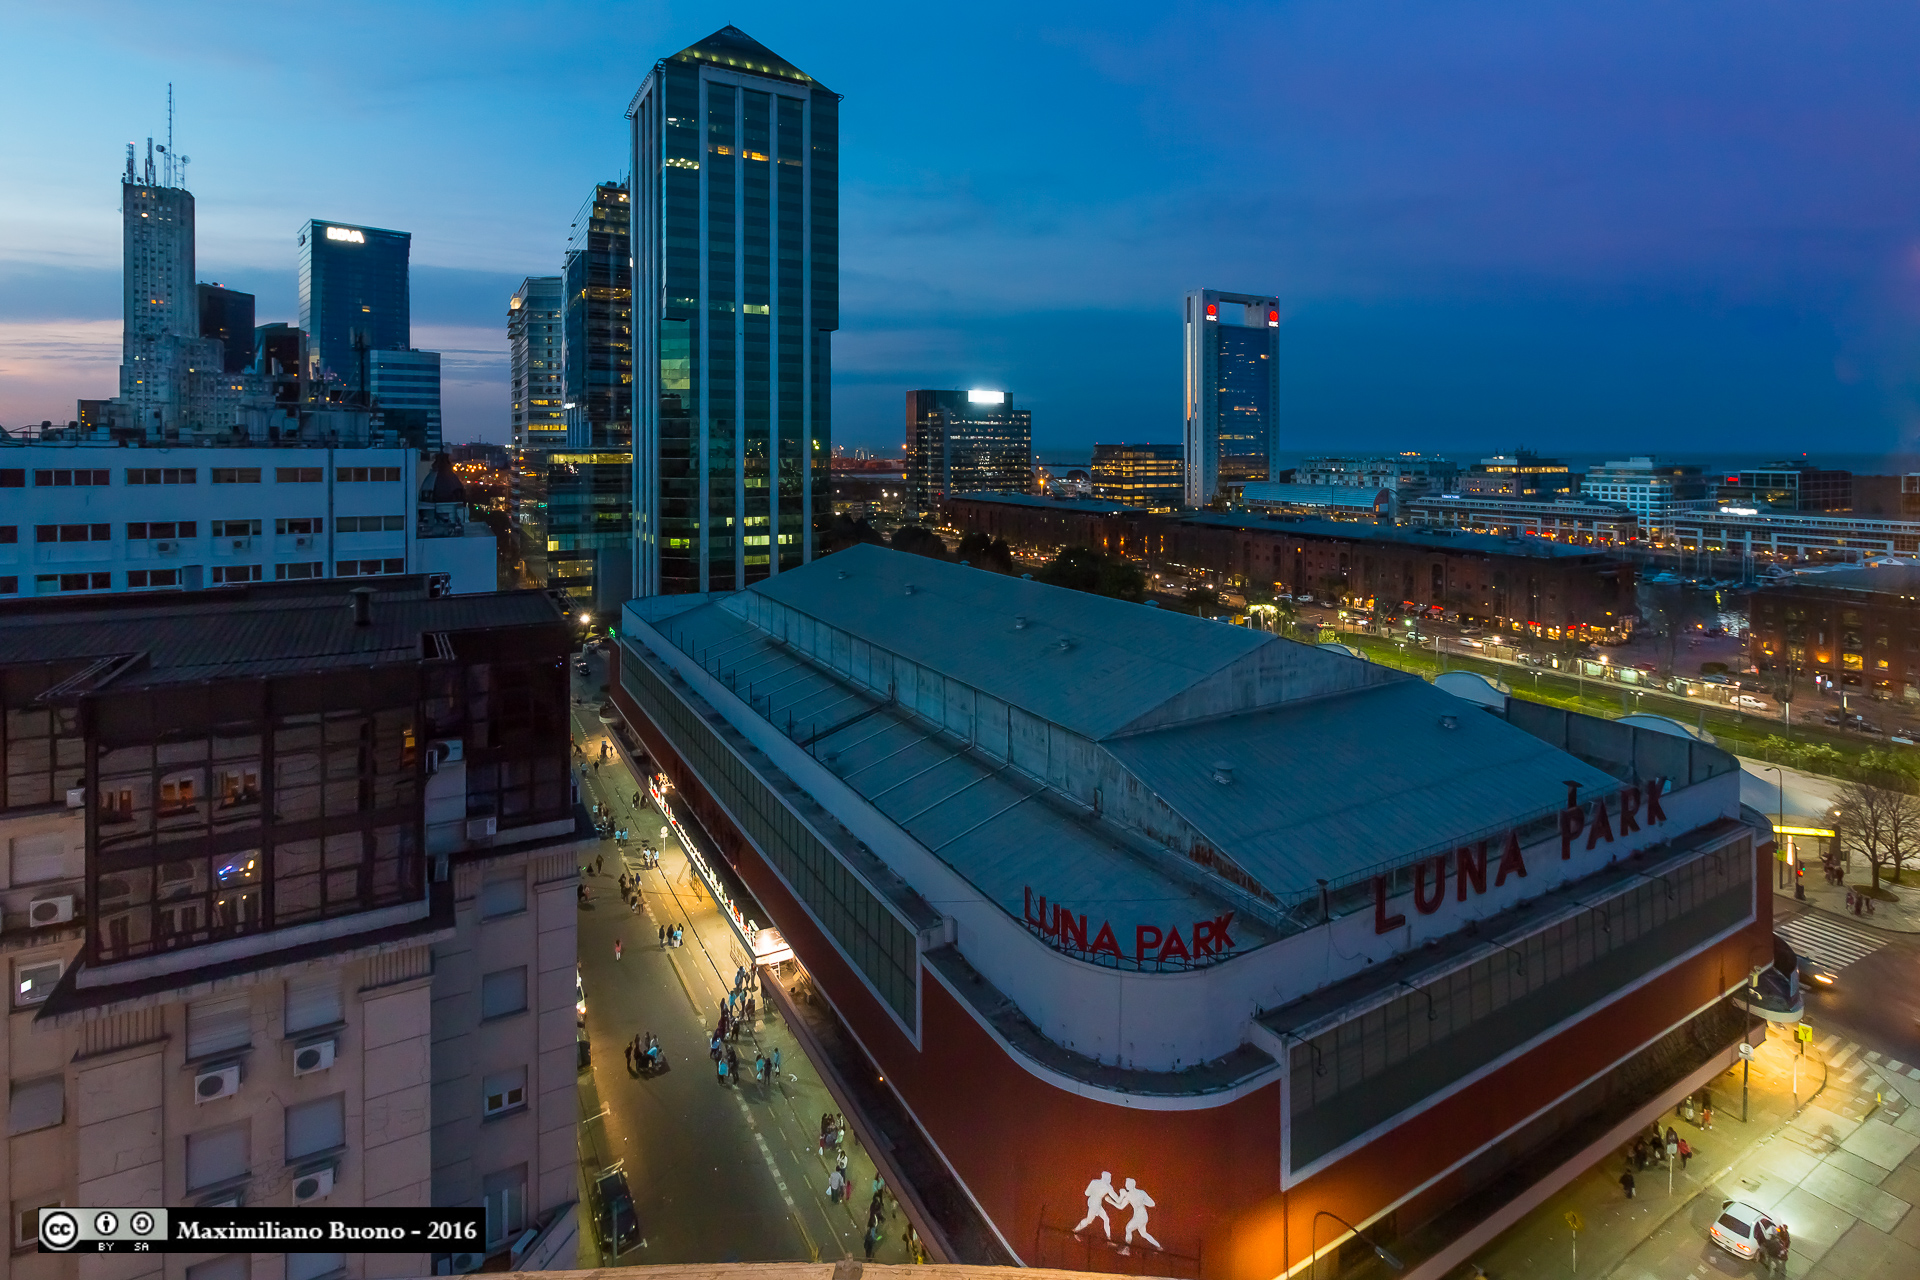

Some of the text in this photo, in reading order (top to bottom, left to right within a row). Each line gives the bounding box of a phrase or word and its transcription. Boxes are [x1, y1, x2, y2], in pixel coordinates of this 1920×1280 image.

[327, 226, 365, 244] BBVA
[1374, 777, 1667, 935] LUNA PARK
[1024, 885, 1236, 962] LUNA PARK
